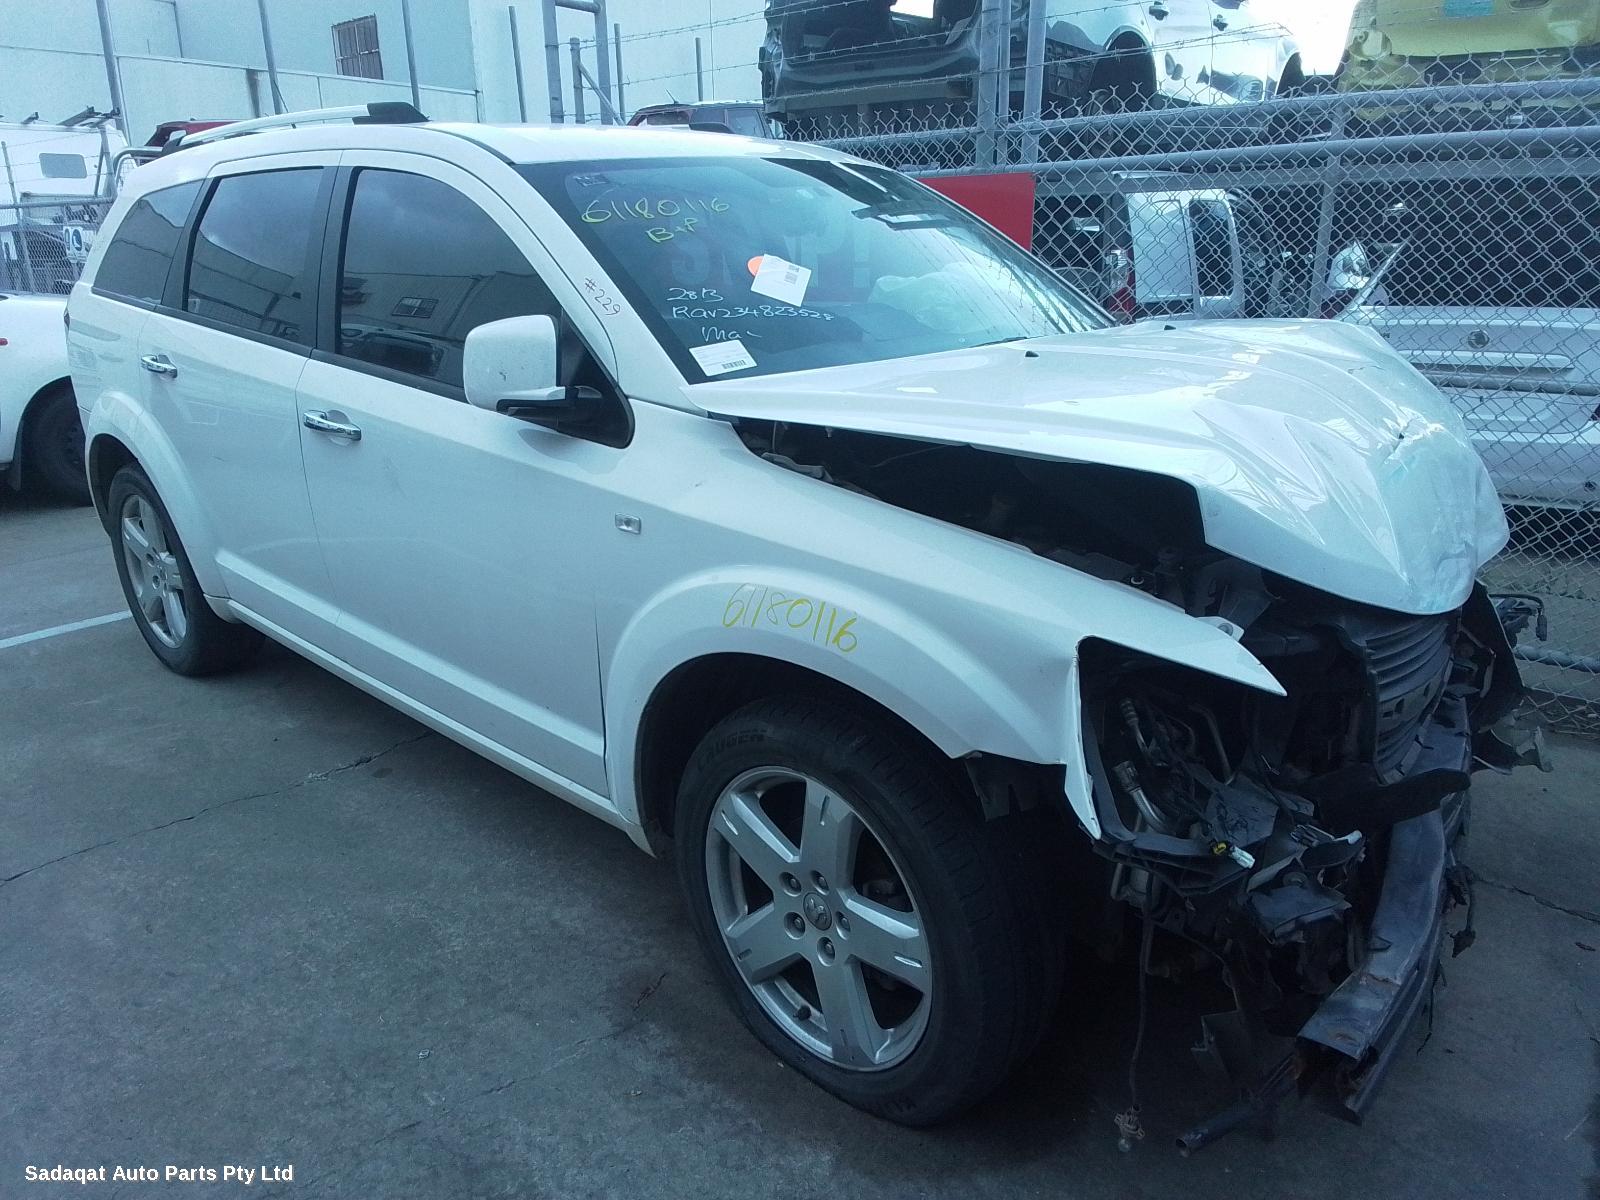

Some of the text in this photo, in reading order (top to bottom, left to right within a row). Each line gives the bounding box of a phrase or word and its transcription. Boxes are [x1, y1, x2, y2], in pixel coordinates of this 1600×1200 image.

[582, 196, 730, 223] 61180116
[584, 277, 621, 316] #229
[723, 583, 857, 652] 61180116
